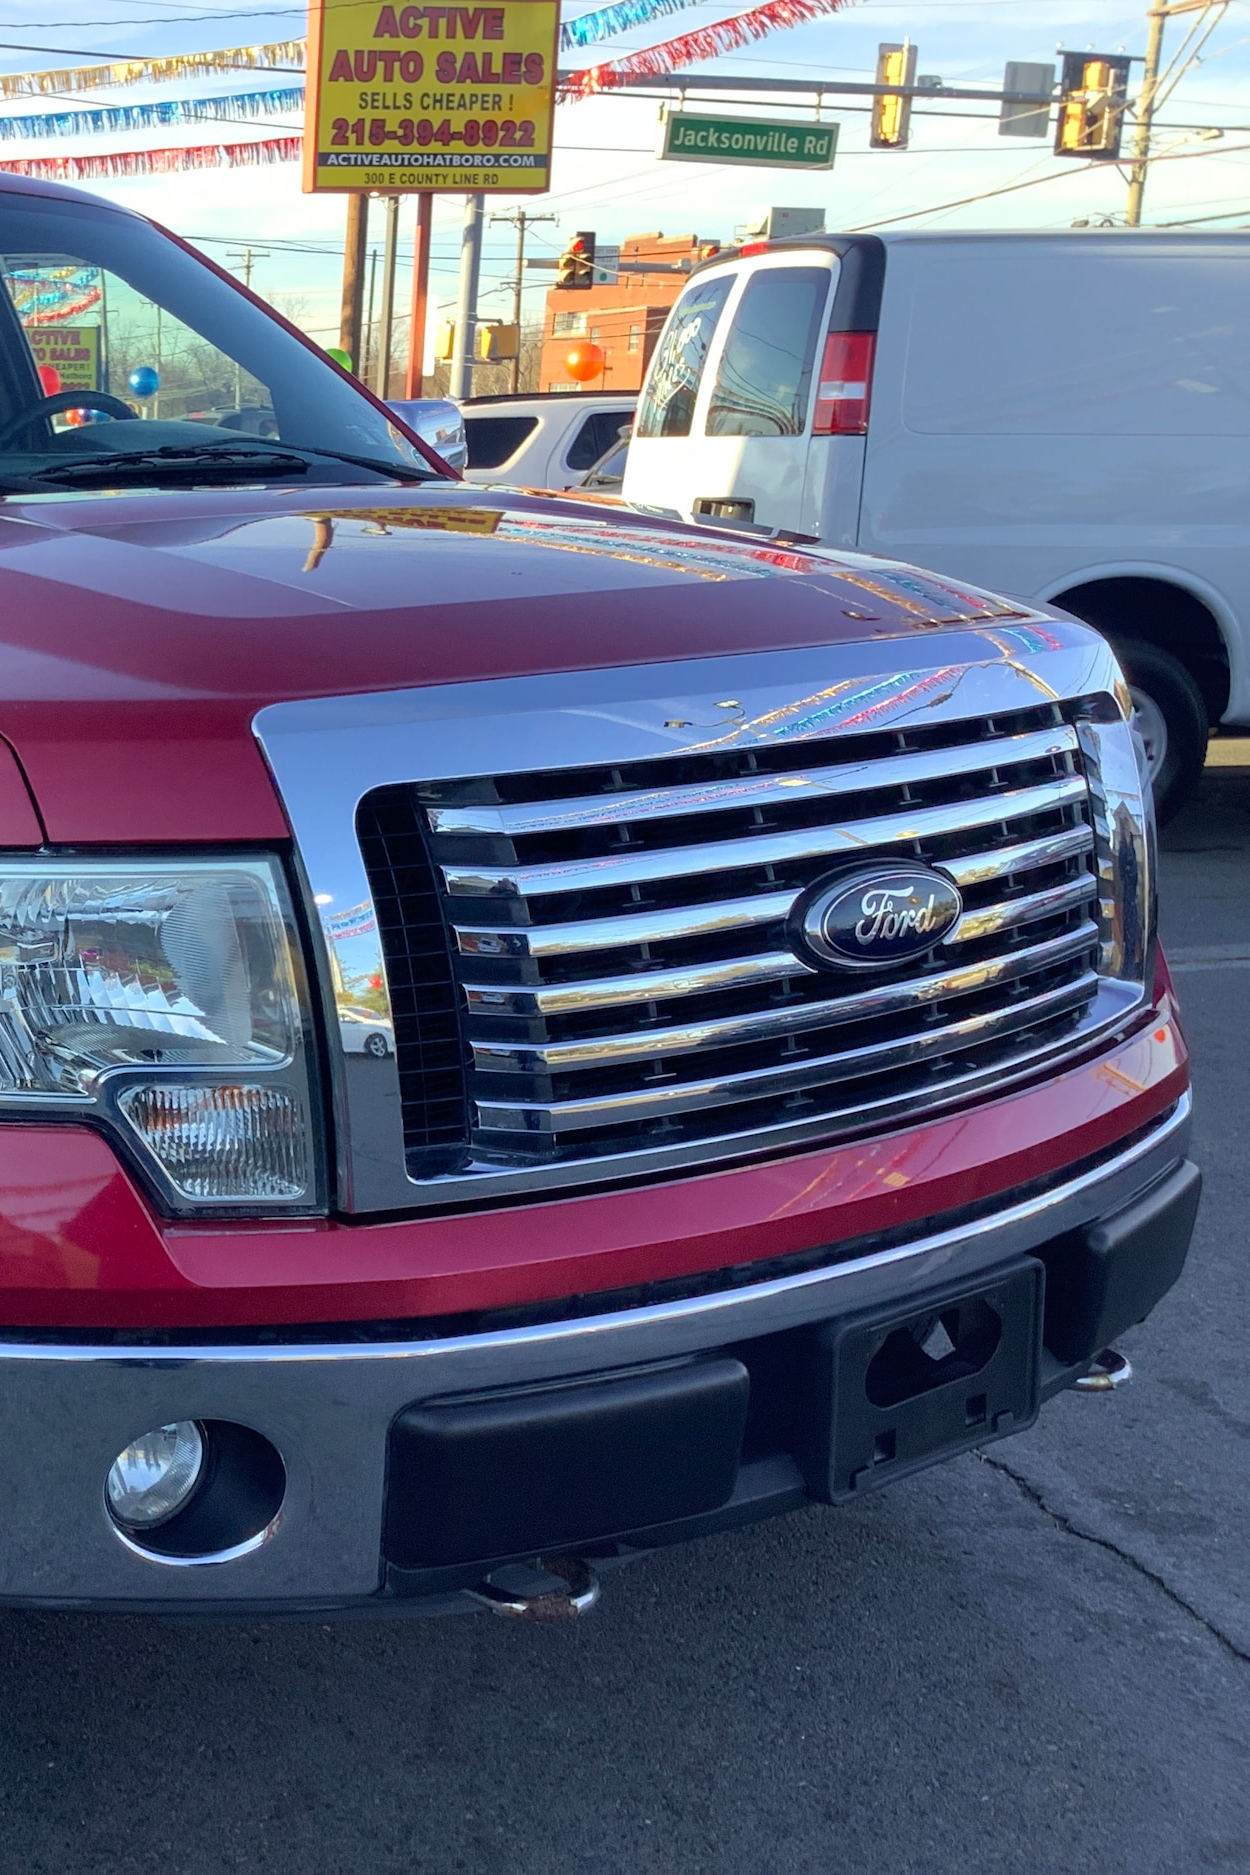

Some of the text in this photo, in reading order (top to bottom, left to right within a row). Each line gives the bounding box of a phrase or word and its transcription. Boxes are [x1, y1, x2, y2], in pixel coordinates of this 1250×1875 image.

[373, 5, 505, 40] ACTIVE
[328, 49, 544, 85] AUTO SALES
[358, 92, 413, 110] SELLS
[420, 92, 503, 111] CHEAPER
[330, 118, 536, 147] 215-394-8922
[673, 126, 830, 155] Jacksonville Rd
[327, 153, 535, 167] ACTIVEAUTOHATBORO.COM
[363, 172, 499, 185] 300 E COUNTY LINE RD
[29, 330, 80, 345] CTIVE
[33, 347, 90, 361] TO SALES
[855, 885, 937, 946] Ford
